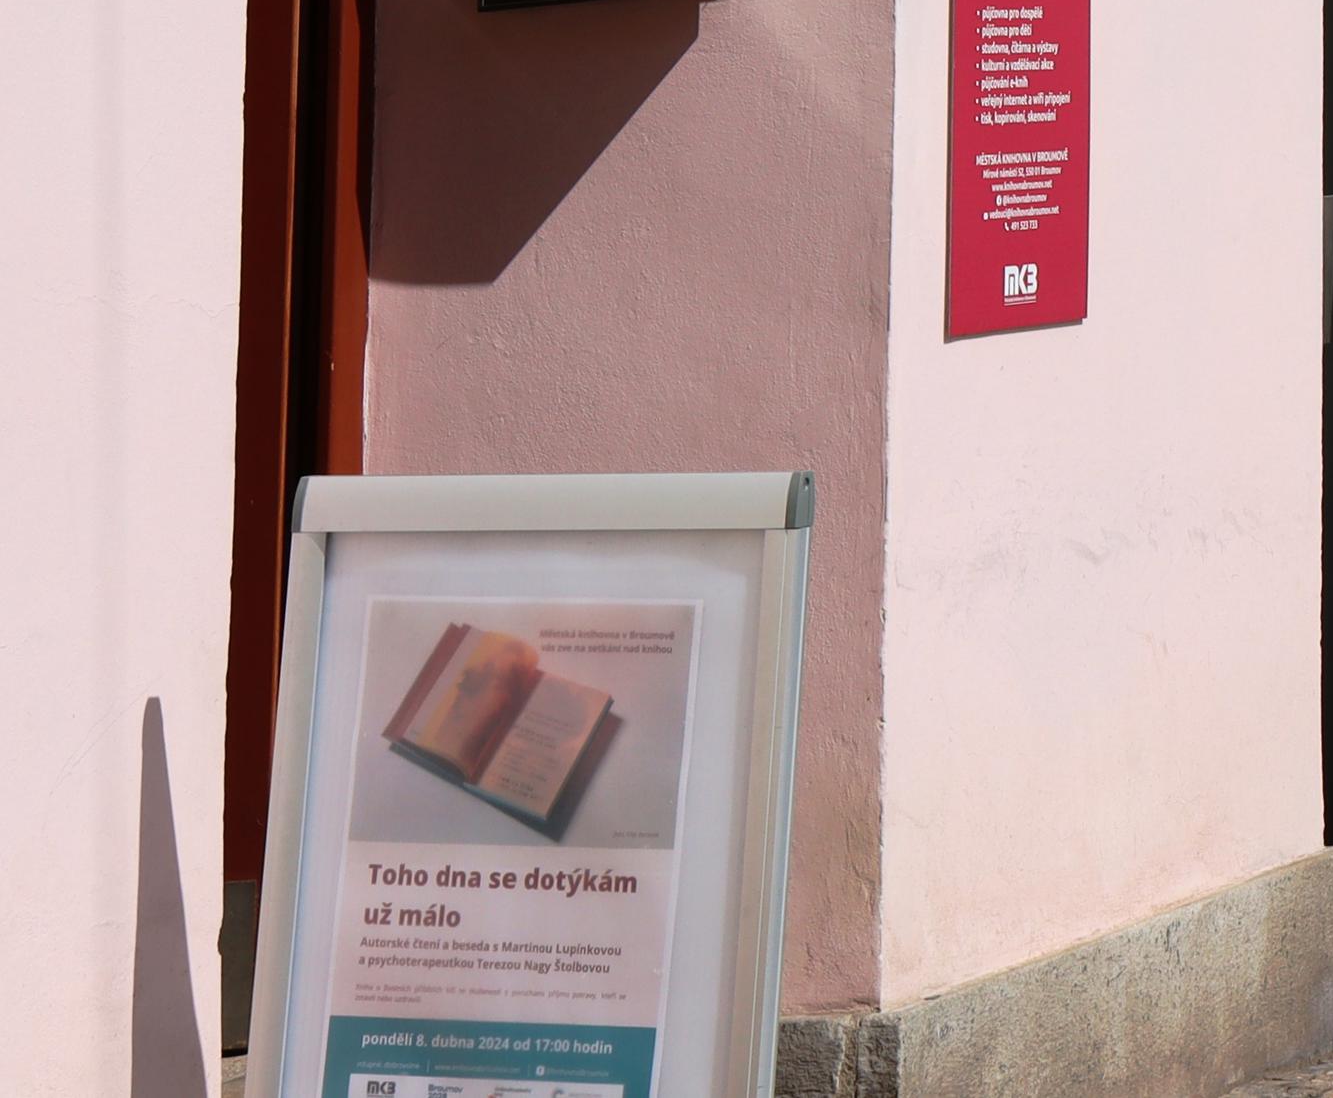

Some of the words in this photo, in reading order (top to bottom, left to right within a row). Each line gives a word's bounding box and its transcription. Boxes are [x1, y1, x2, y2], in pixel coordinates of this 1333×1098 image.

[976, 151, 1001, 166] MĚSTSKÁ
[1002, 152, 1031, 164] KNIHOVNA
[641, 644, 673, 654] knihou
[368, 863, 428, 887] Toho
[436, 865, 482, 889] dna
[488, 871, 517, 889] se
[524, 867, 637, 898] dotýkám
[364, 902, 392, 926] už
[398, 903, 461, 928] málo
[360, 936, 410, 949] Autorské
[412, 937, 440, 950] čtení
[442, 942, 449, 950] a
[451, 939, 490, 952] beseda
[502, 941, 552, 954] Martinou
[556, 943, 622, 958] Lupínkovou
[359, 957, 366, 965] a
[367, 955, 474, 970] psychoterapeutkou
[476, 958, 521, 971] Terezou
[523, 961, 551, 975] Nagy
[554, 958, 610, 974] Štolbovou
[362, 1032, 414, 1048] pondělí
[416, 1035, 427, 1047] 8.
[431, 1036, 475, 1049] dubna
[477, 1037, 509, 1050] 2024
[513, 1038, 530, 1051] od
[535, 1039, 570, 1052] 17:00
[573, 1040, 613, 1055] hodin
